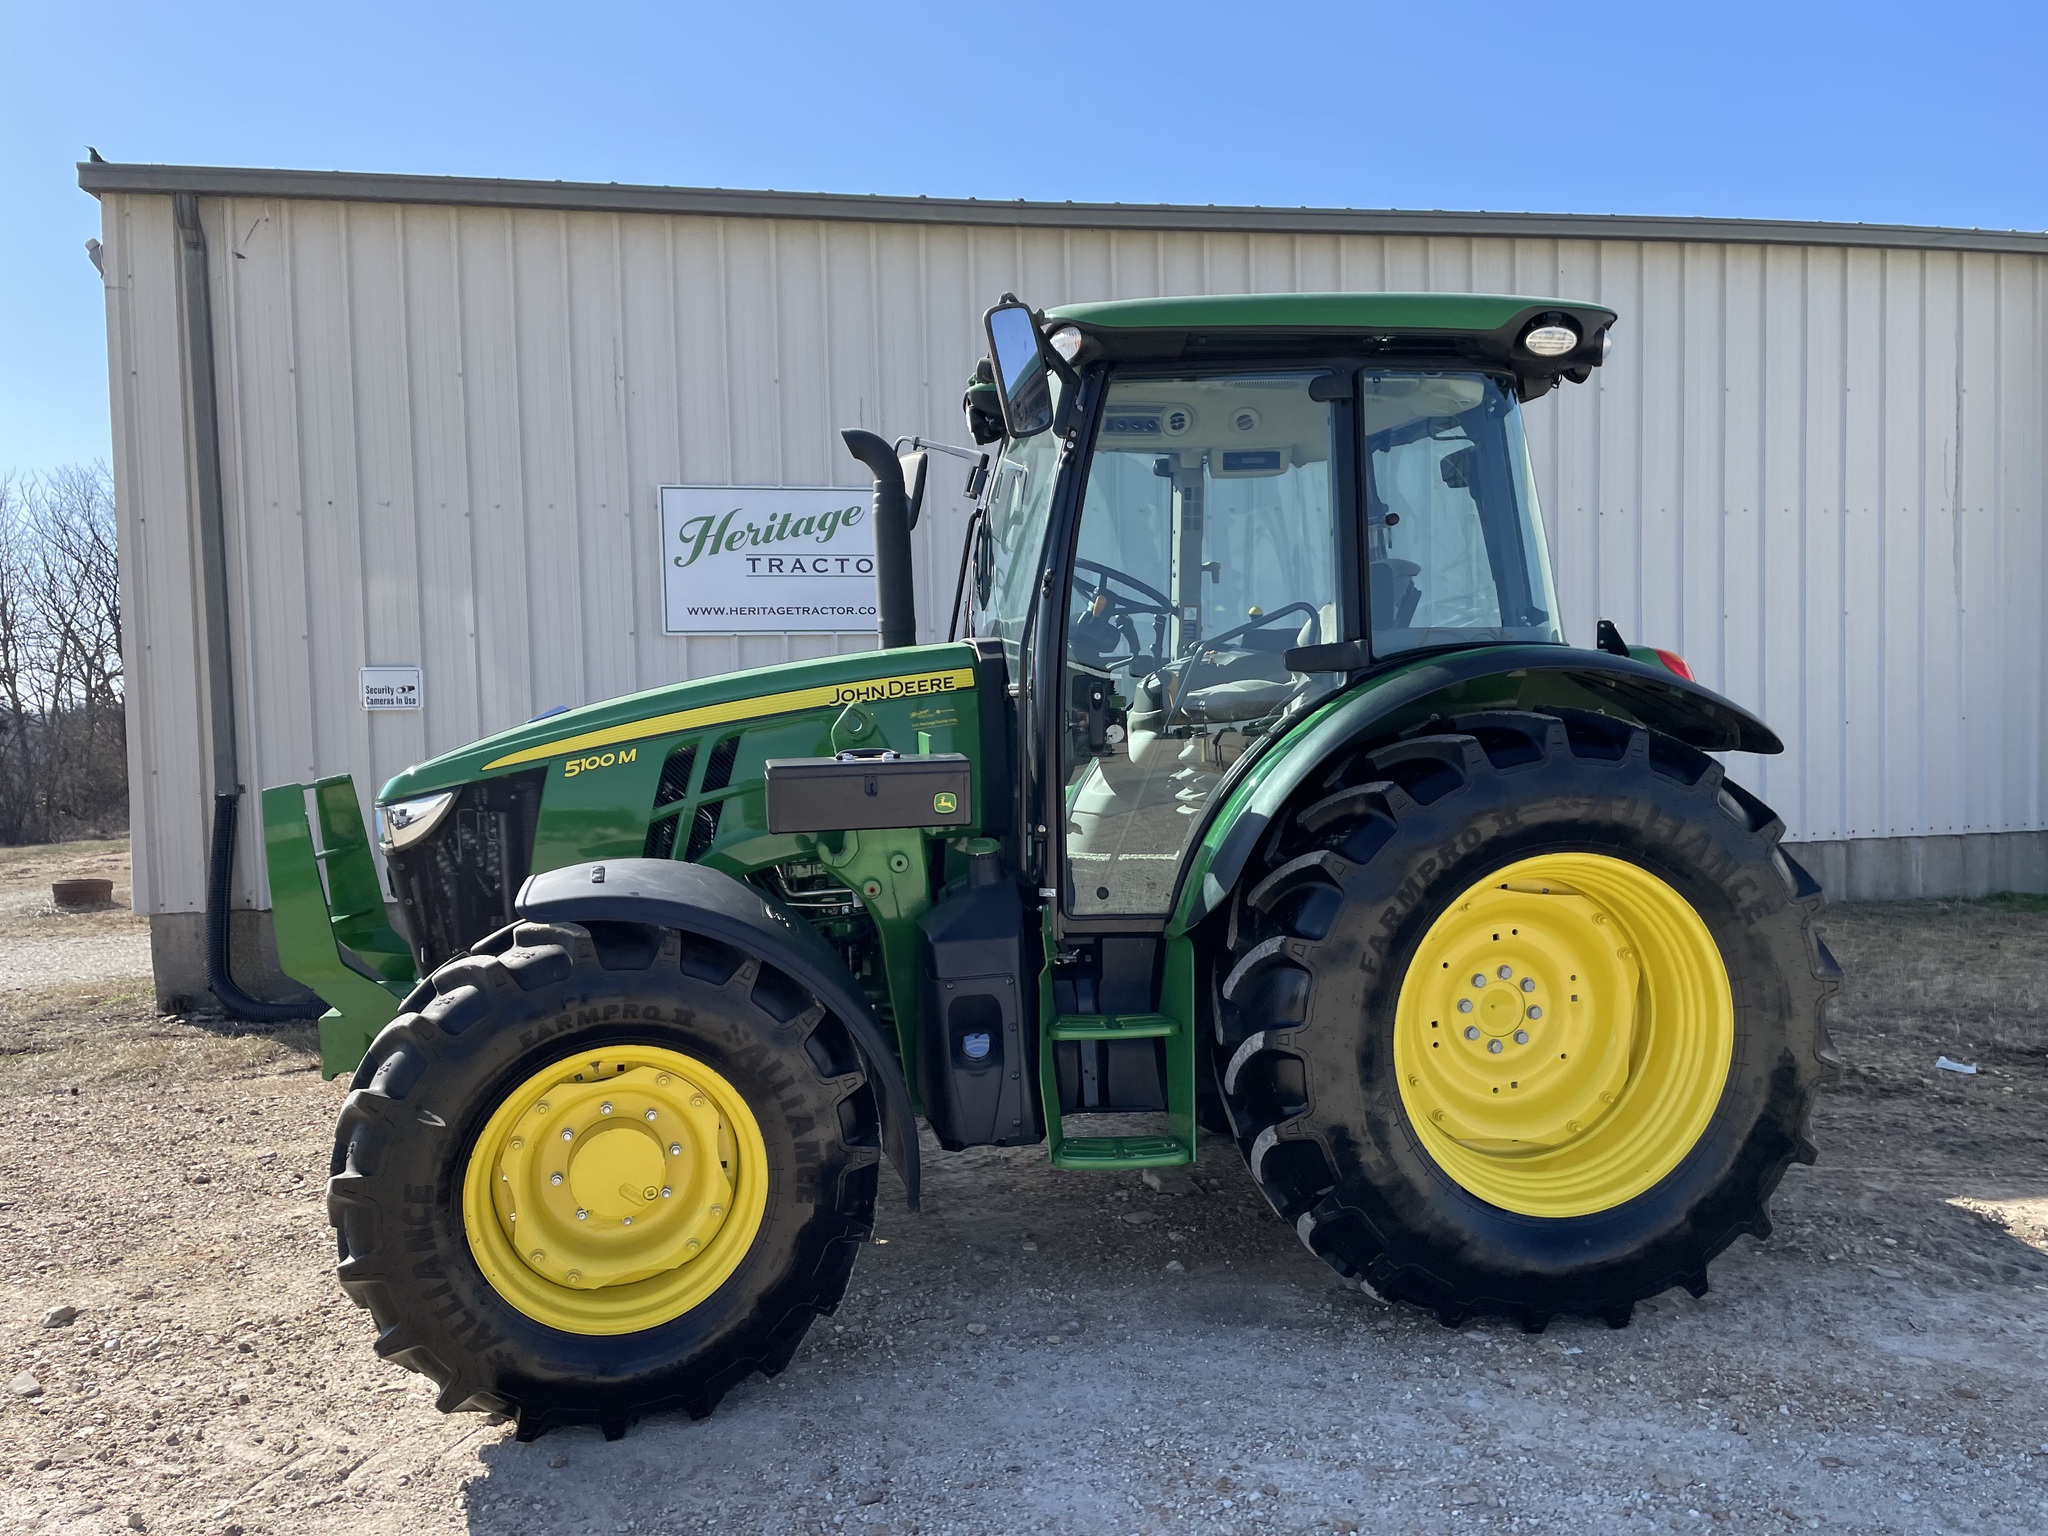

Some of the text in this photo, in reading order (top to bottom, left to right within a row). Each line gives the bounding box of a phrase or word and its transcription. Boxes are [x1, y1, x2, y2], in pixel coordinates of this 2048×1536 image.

[673, 505, 865, 568] Heritage
[745, 557, 874, 574] TRACTO
[686, 605, 877, 617] WWW.HERITAGETRACTOR.CO
[365, 685, 395, 696] Security
[365, 696, 417, 705] Cameras In Use
[829, 676, 955, 704] JOHN DEERE
[1359, 827, 1482, 976] FARMPRO
[517, 1003, 662, 1049] FARMPRO
